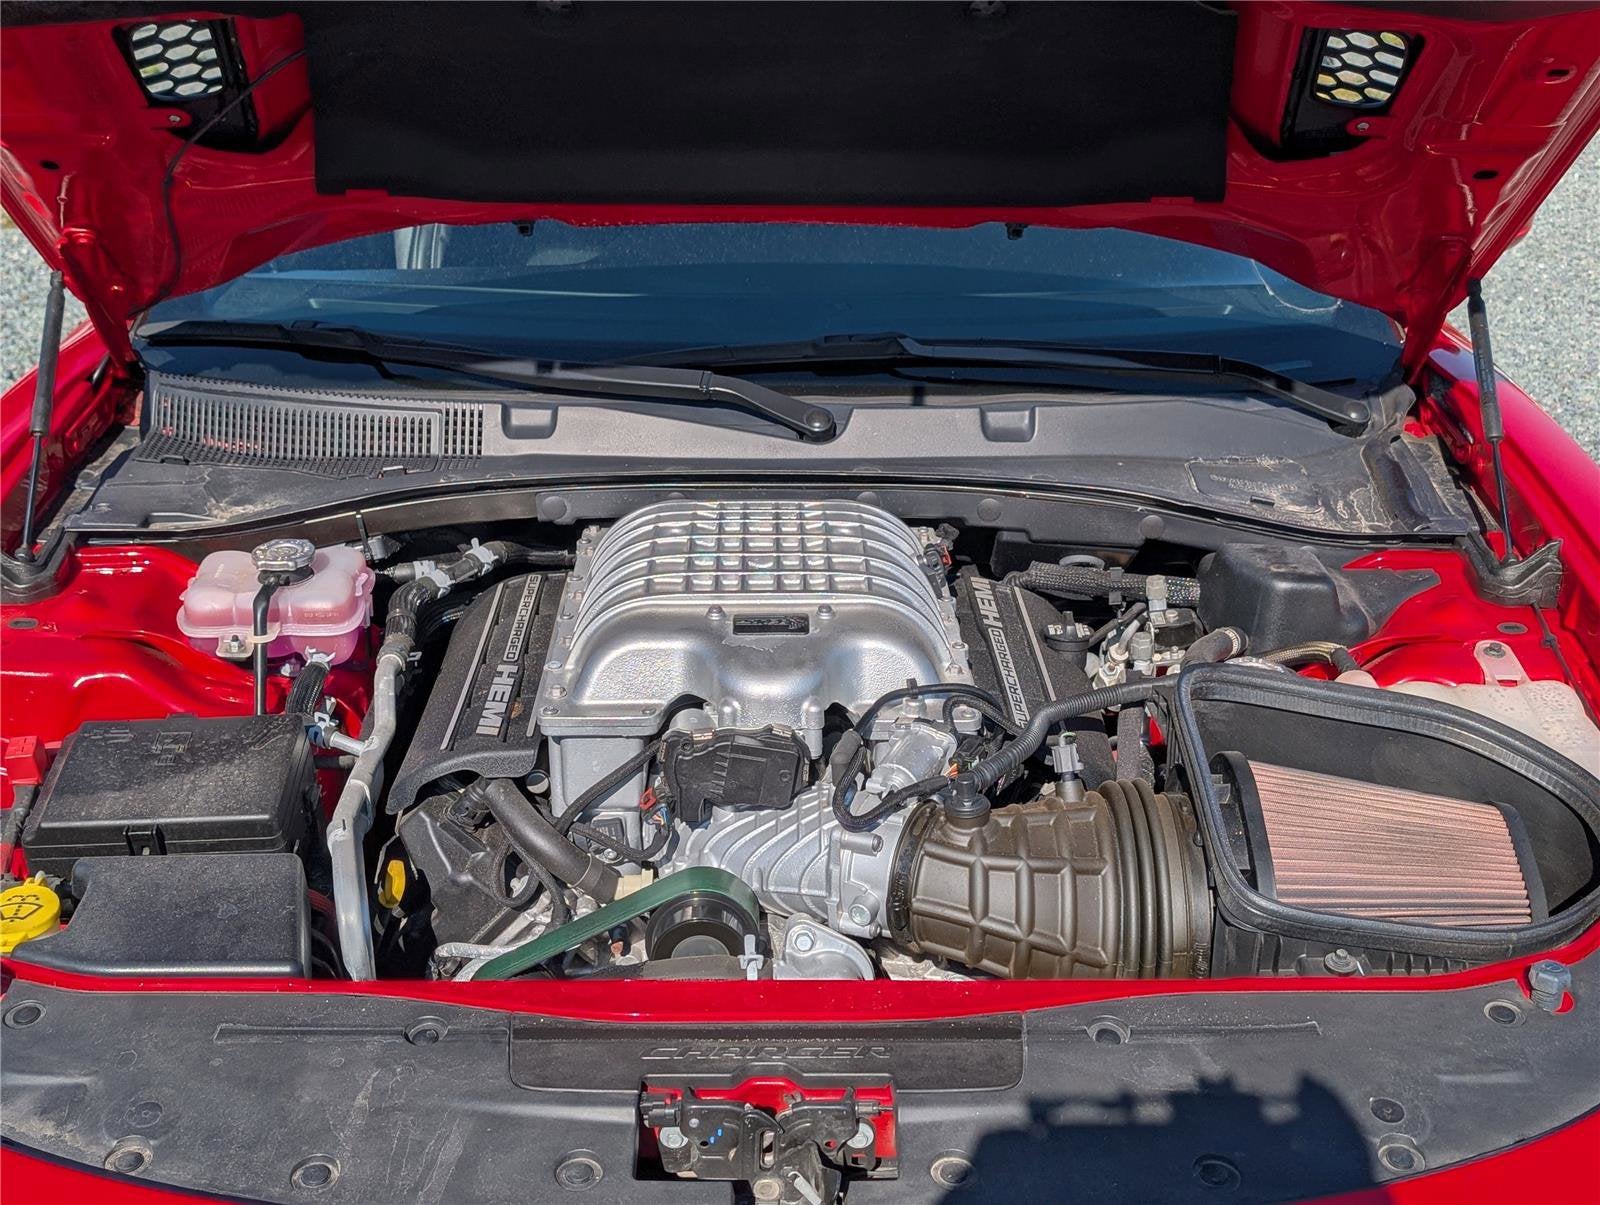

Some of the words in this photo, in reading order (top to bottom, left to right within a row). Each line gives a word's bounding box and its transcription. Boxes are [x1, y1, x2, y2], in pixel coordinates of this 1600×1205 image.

[505, 574, 540, 661] SUPERCHARGED
[970, 576, 1003, 630] HEMI
[476, 664, 519, 737] HEMI
[639, 1046, 891, 1060] CHARGER
